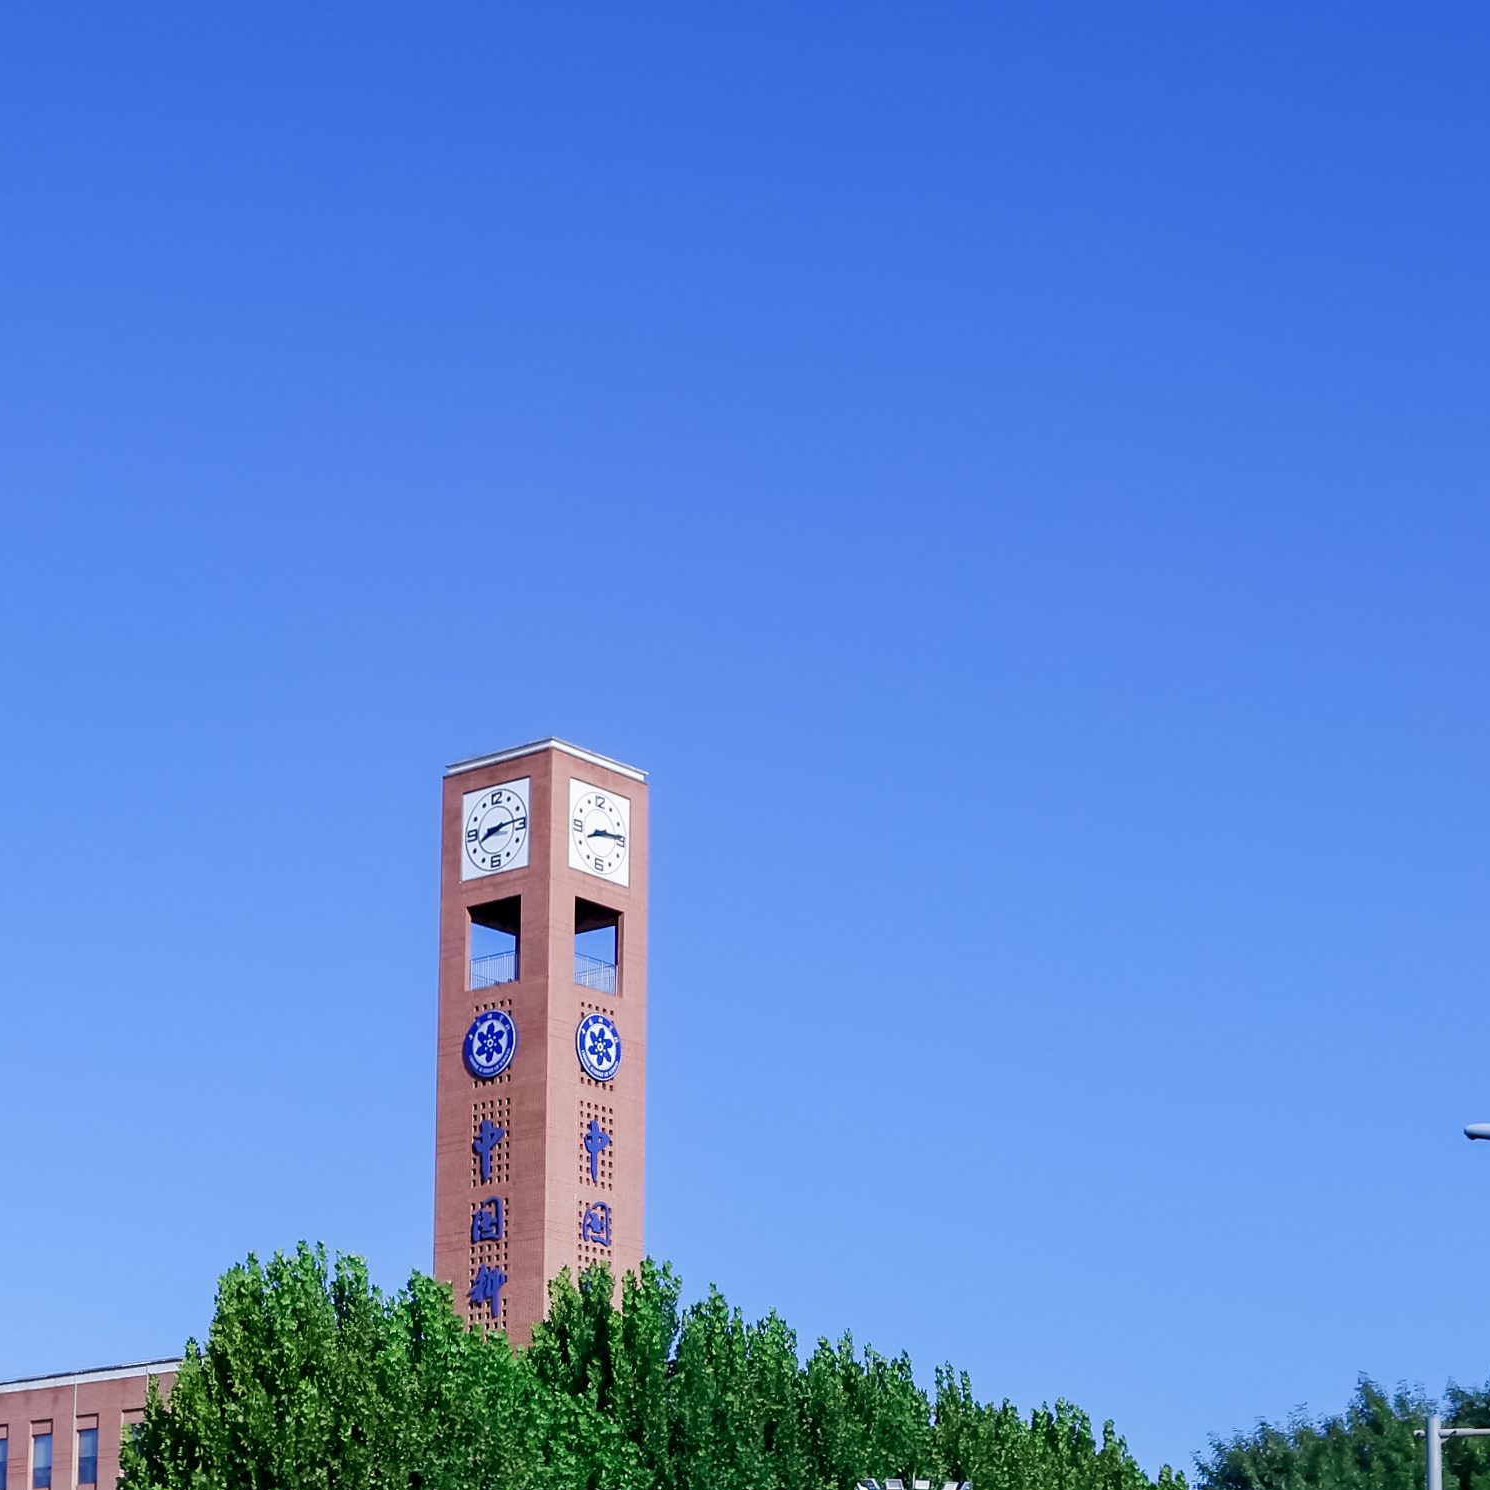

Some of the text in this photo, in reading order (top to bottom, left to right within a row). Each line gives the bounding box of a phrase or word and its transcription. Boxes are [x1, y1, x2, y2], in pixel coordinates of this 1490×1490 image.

[490, 791, 503, 806] 12
[595, 795, 606, 810] 12
[573, 818, 583, 833] 9
[467, 828, 478, 843] 9
[490, 854, 502, 869] 6
[594, 857, 604, 872] 6
